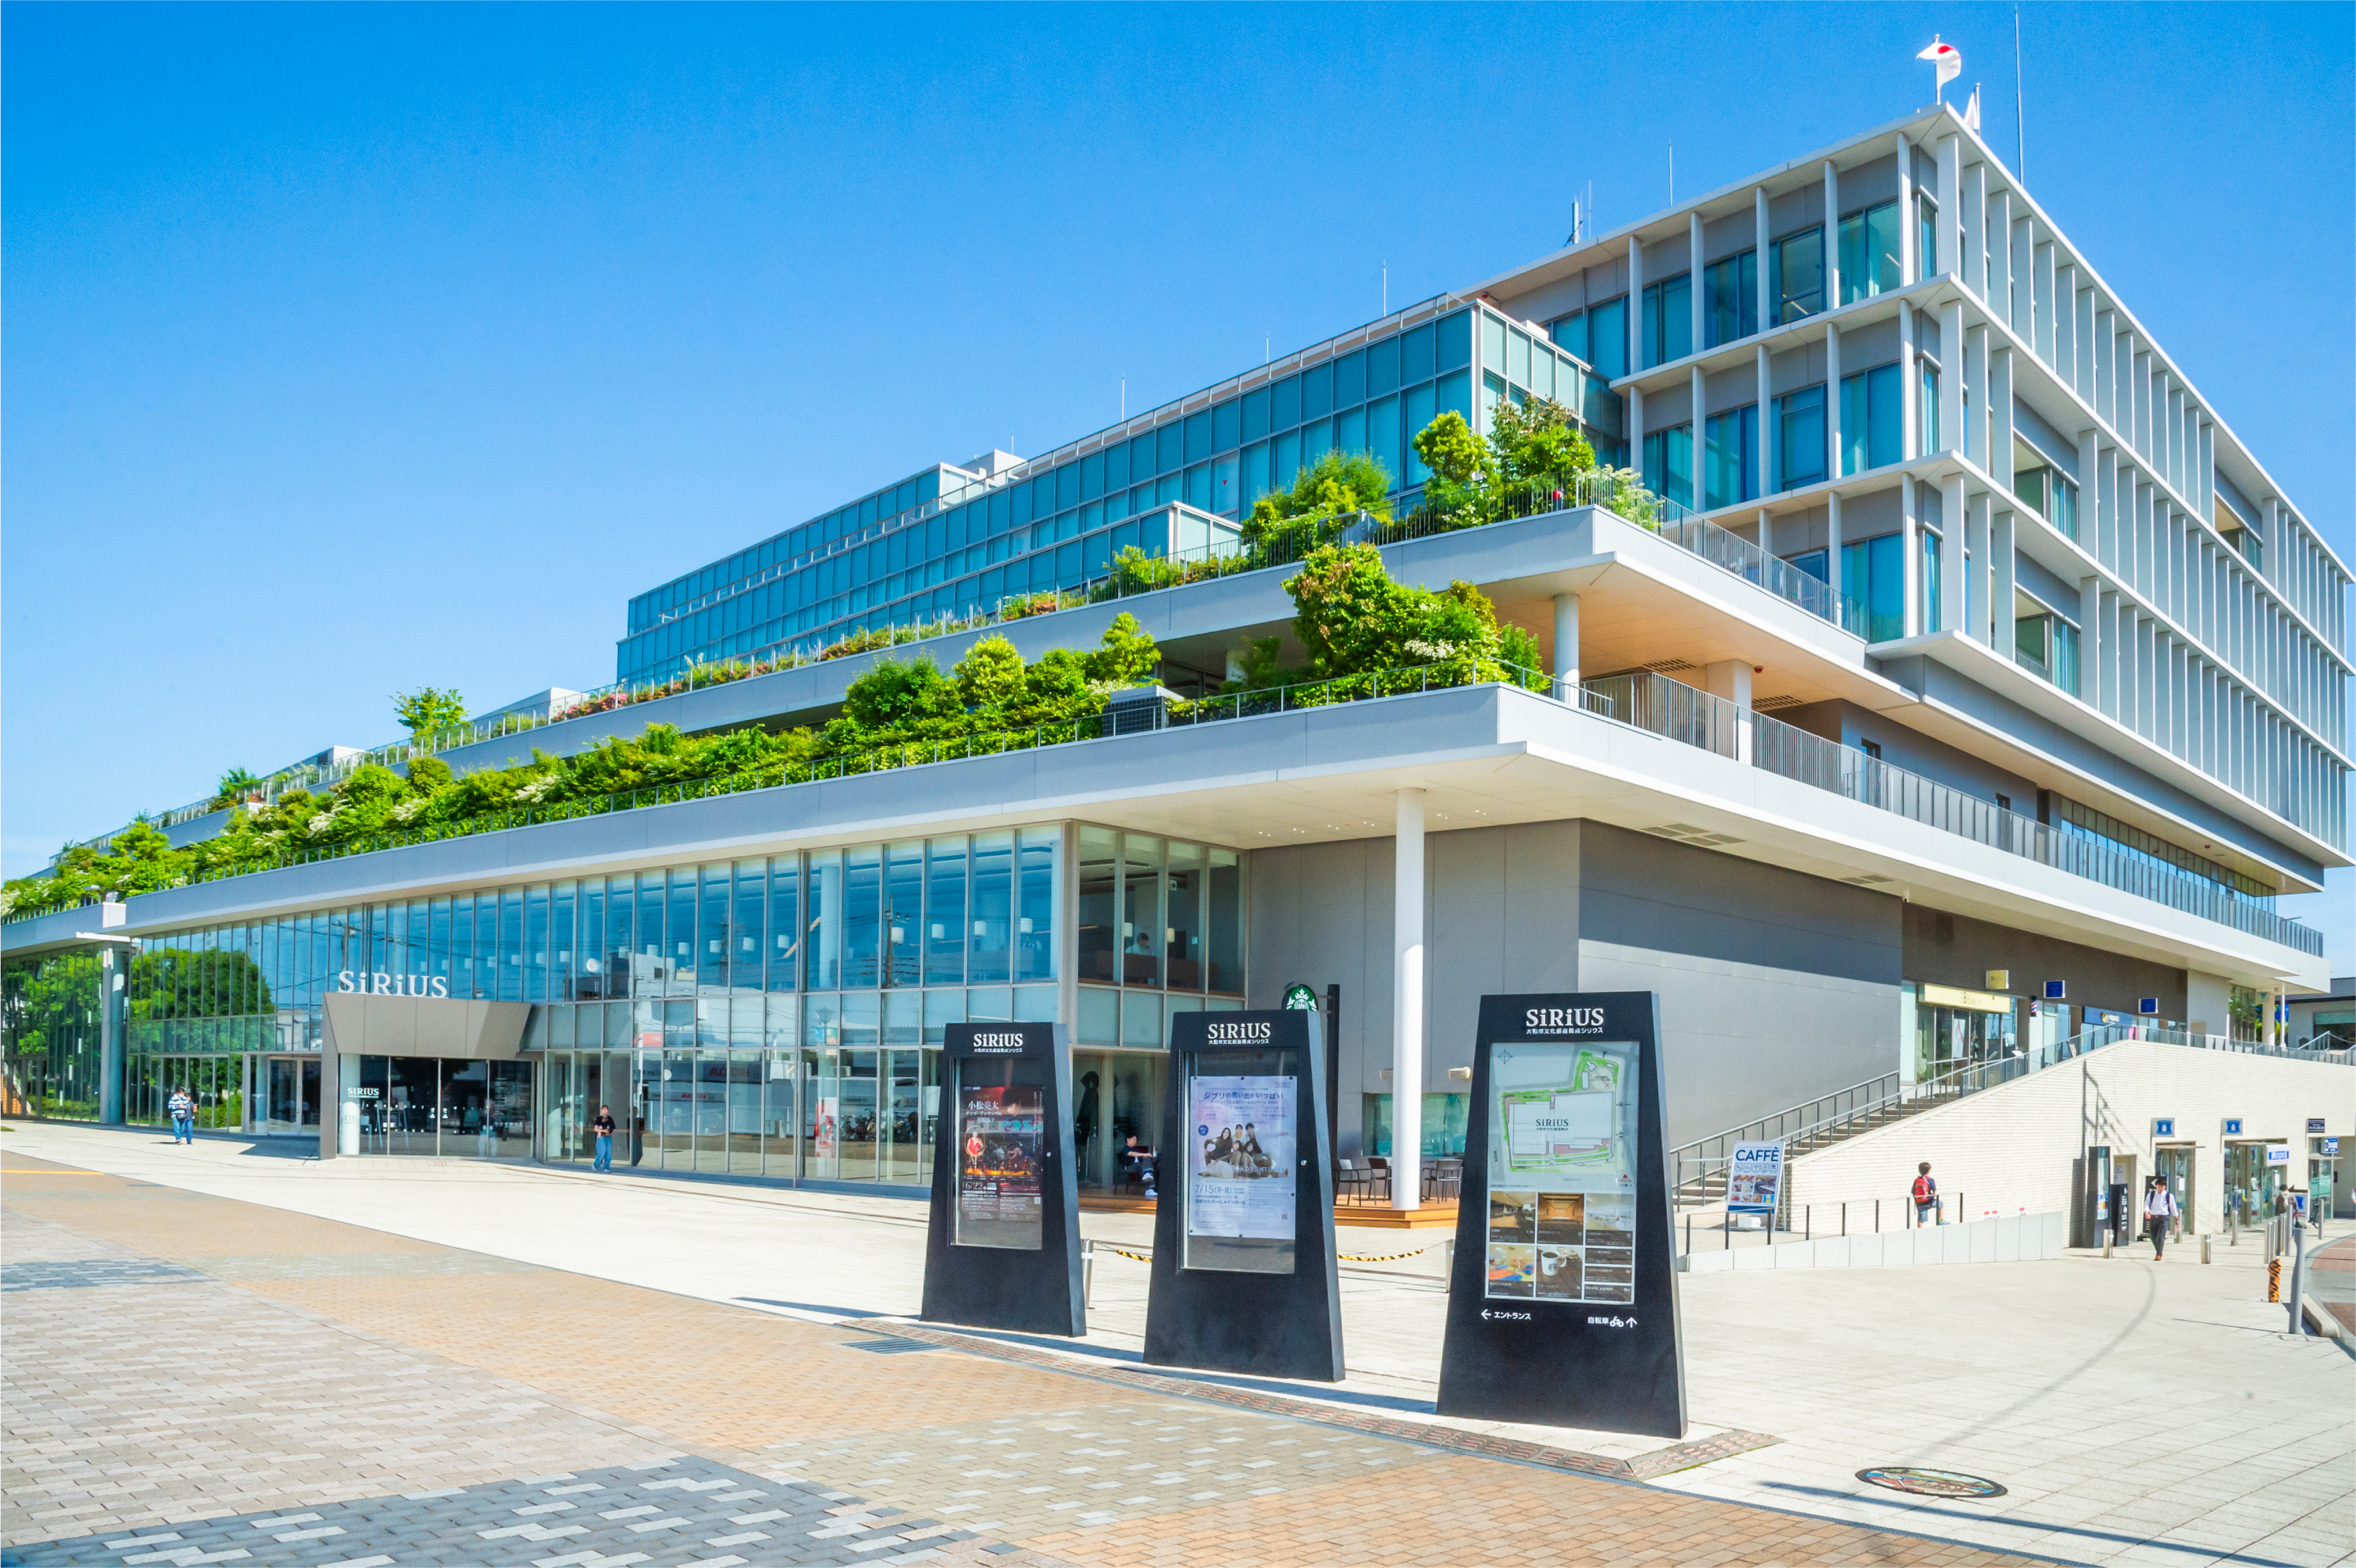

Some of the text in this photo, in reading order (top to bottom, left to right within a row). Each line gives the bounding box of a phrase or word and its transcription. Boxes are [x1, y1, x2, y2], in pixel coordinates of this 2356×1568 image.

[337, 971, 448, 998] SiRiUS
[1525, 1008, 1604, 1027] SiRiUS
[1208, 1023, 1270, 1038] SiRiUS
[973, 1033, 1023, 1047] SiRiUS
[1204, 1091, 1284, 1100] ジブリの思い出がいっぱい
[968, 1100, 999, 1110] 小松亮太
[1736, 1147, 1780, 1162] CAFFÈ
[1494, 1311, 1532, 1321] エントランス
